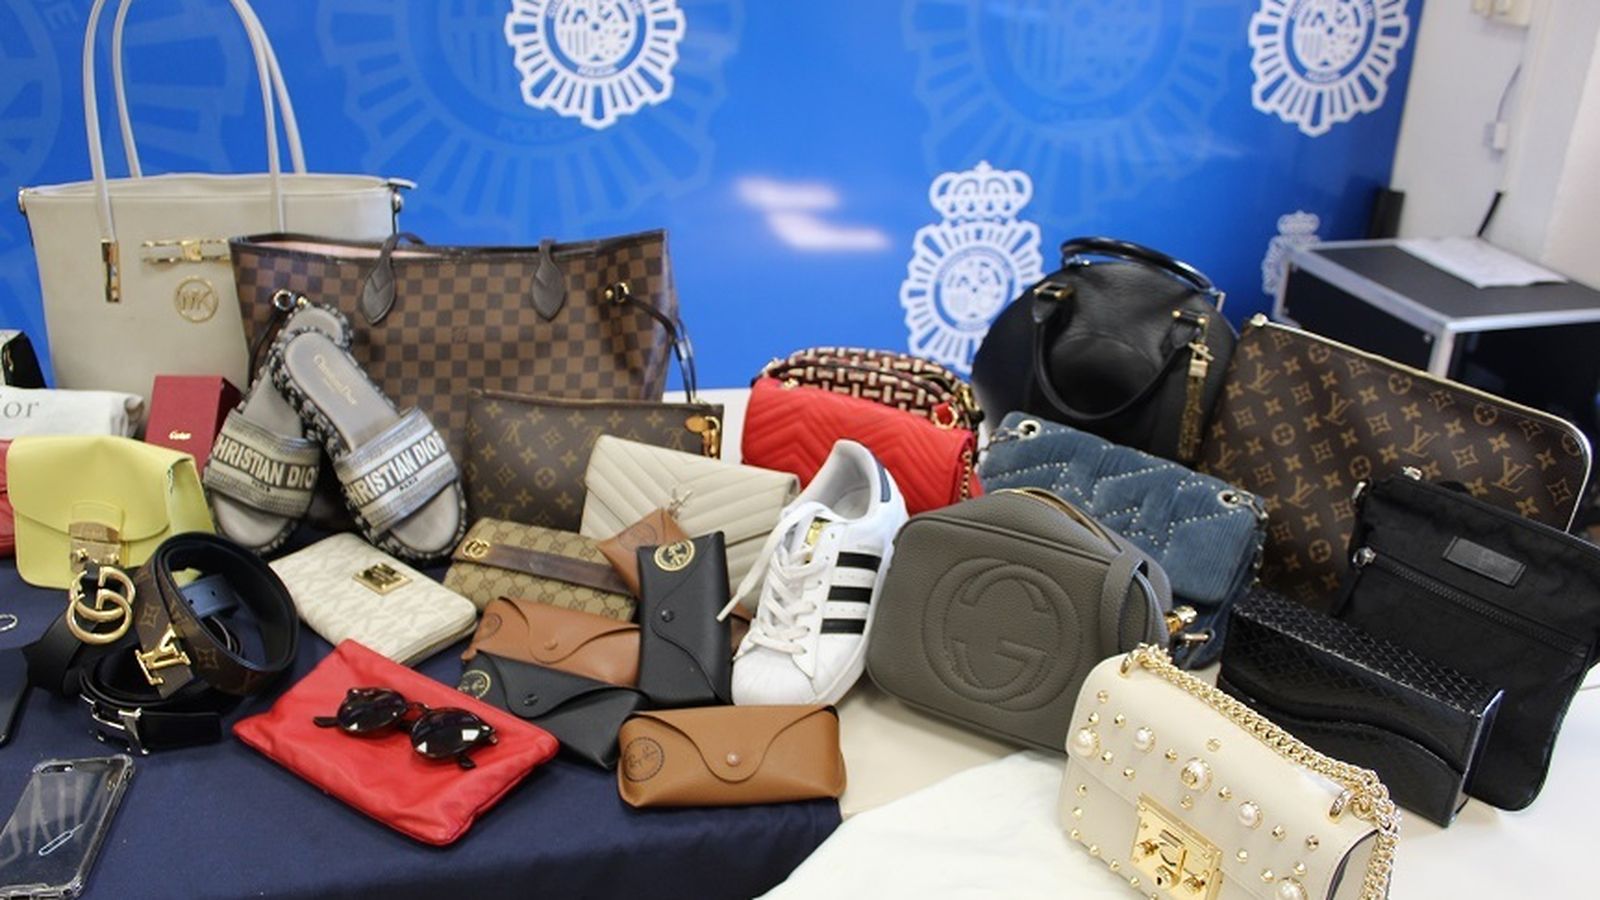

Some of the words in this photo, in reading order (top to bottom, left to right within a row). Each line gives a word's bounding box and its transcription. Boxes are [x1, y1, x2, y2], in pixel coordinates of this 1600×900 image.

[1, 398, 40, 419] or
[211, 434, 285, 487] HRISTIAN
[286, 463, 320, 490] DIO
